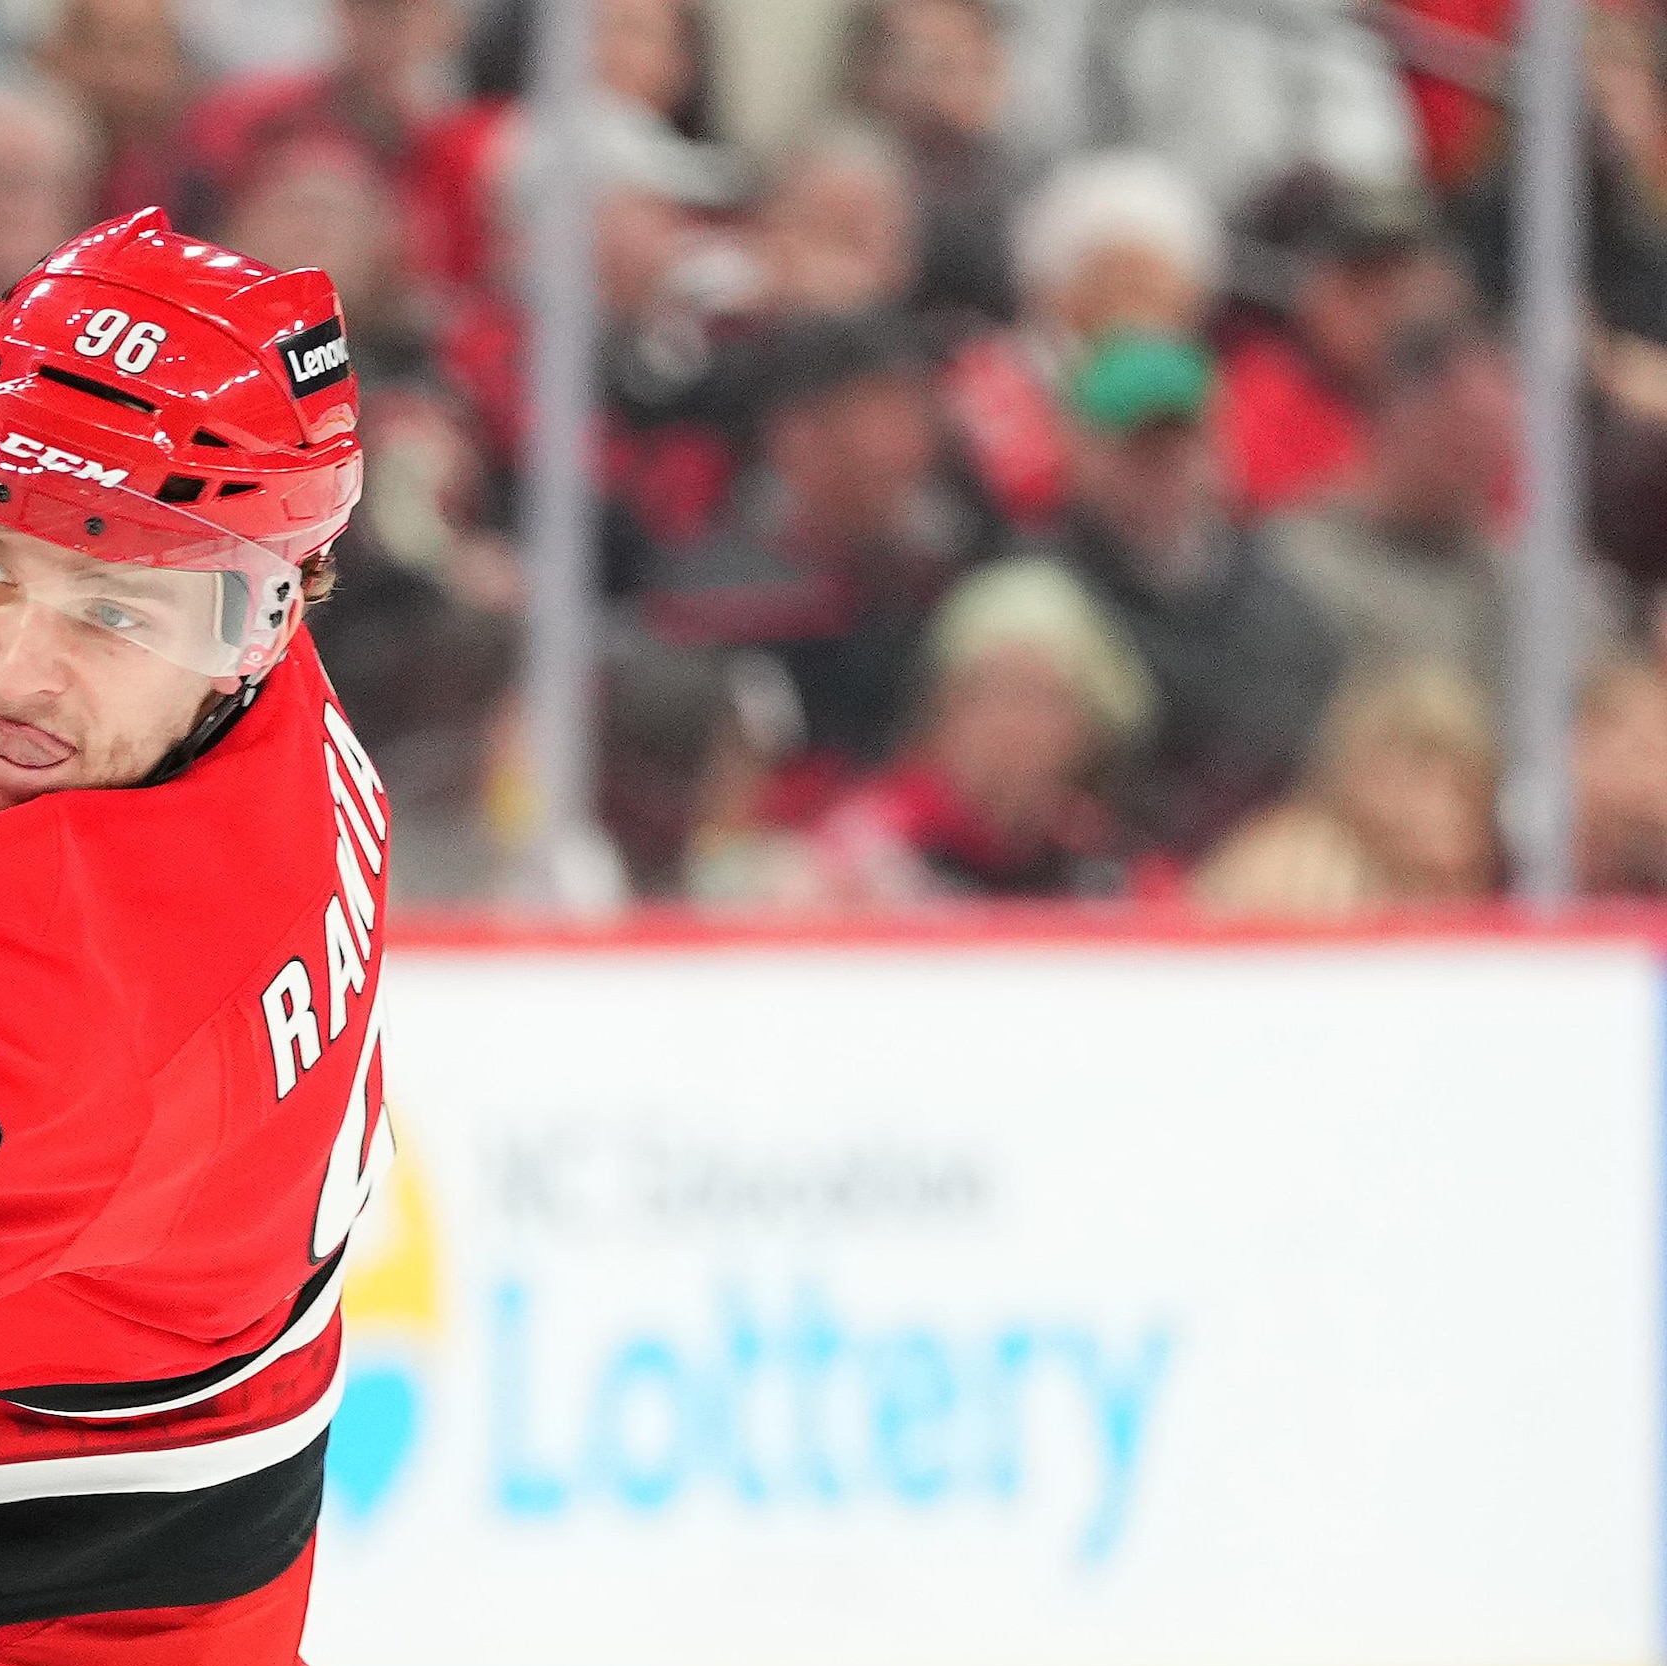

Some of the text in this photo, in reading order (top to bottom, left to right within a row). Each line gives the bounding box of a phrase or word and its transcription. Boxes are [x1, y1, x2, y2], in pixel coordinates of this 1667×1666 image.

[74, 307, 167, 374] 96
[287, 335, 349, 382] Lenov
[0, 432, 129, 488] CCM
[489, 1272, 1182, 1565] Lottery
